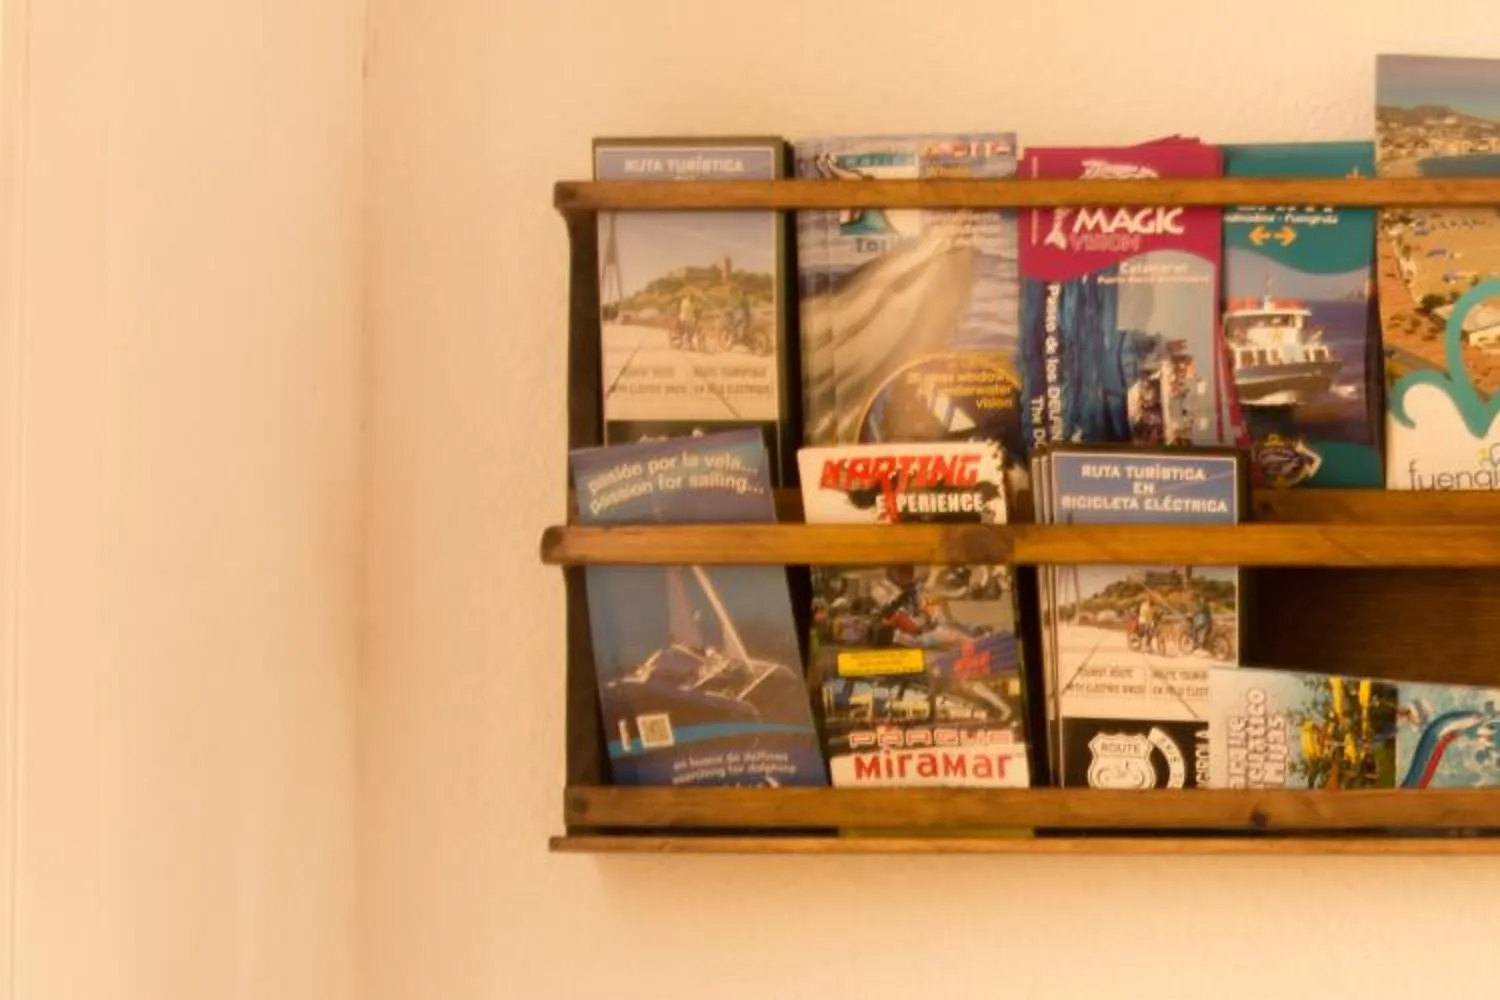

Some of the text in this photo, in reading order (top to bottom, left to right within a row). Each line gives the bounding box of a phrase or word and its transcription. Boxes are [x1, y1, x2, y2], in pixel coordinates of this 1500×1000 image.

[1071, 206, 1186, 235] MAGIC
[1047, 385, 1064, 442] DELFIN
[588, 463, 643, 494] pasión
[648, 454, 677, 476] por
[682, 450, 699, 467] la
[658, 473, 683, 491] for
[819, 453, 983, 490] KARTING
[1081, 463, 1207, 481] RUTA TURÍSTICA
[1132, 482, 1155, 496] EN
[1061, 495, 1140, 511] BICICLETA
